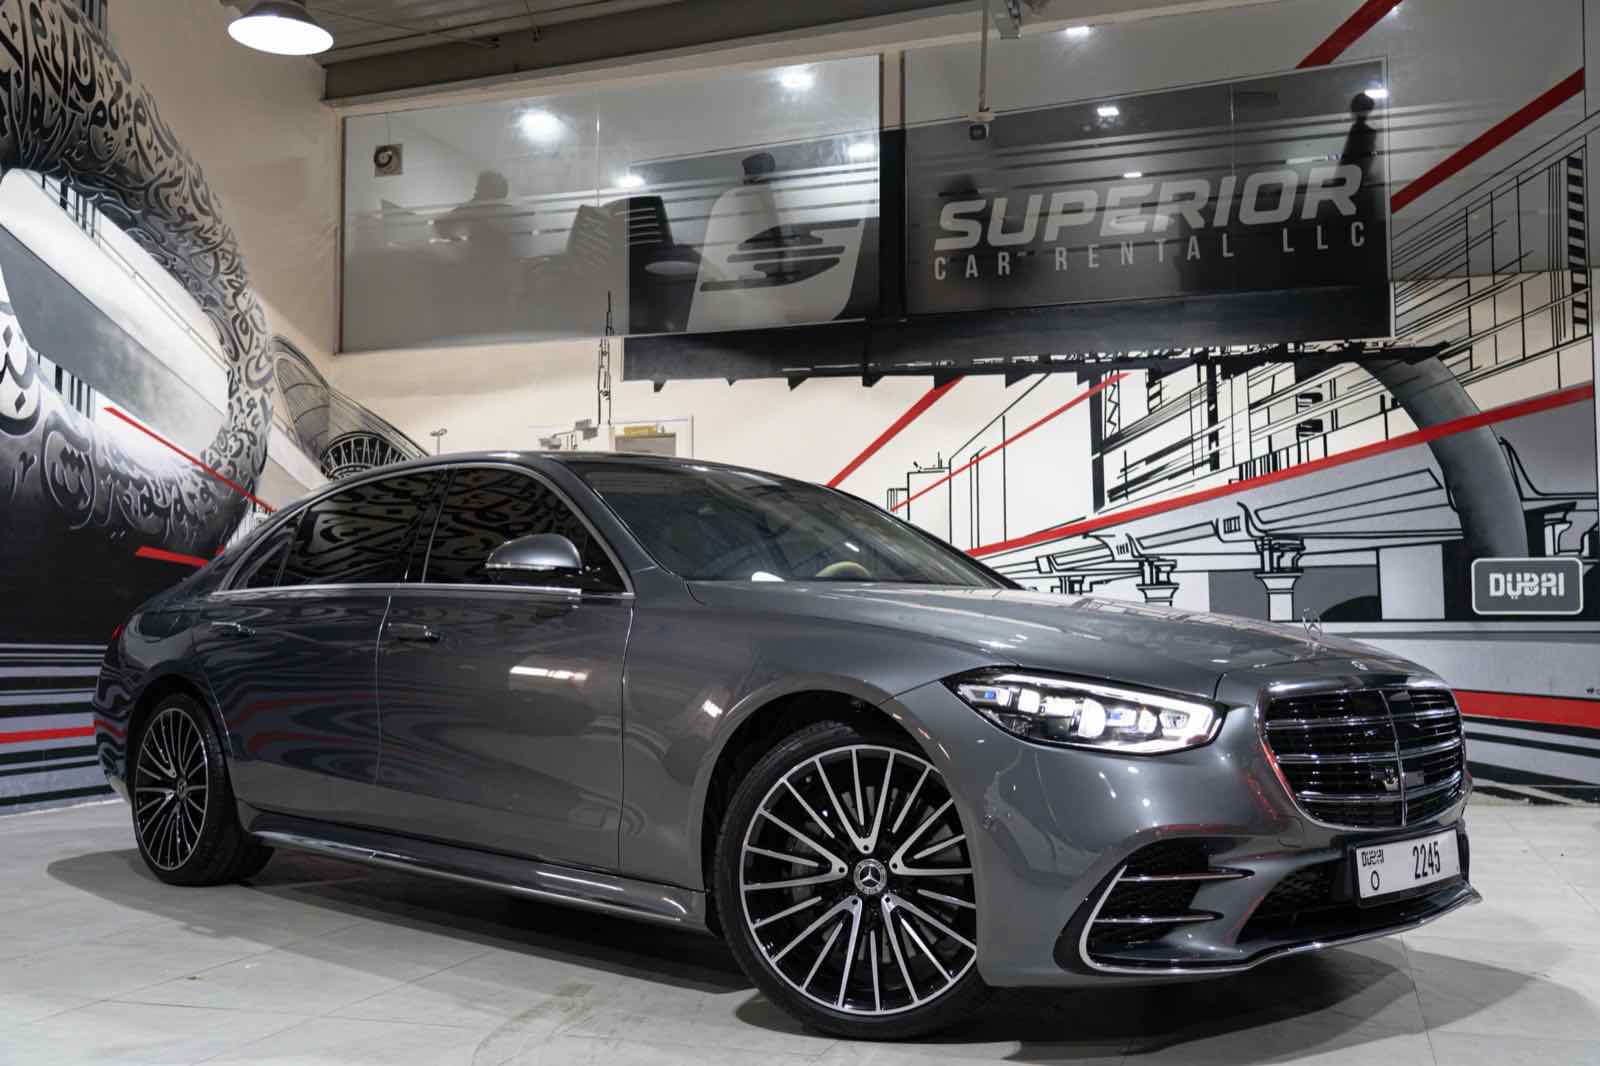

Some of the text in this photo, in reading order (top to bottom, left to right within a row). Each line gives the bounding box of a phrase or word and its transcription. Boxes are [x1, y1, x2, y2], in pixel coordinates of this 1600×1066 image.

[934, 163, 1363, 251] SUPERIOR
[934, 221, 1366, 281] CAR RENTAL LLC
[1489, 572, 1565, 599] DUBAI
[1413, 841, 1441, 880] 2245
